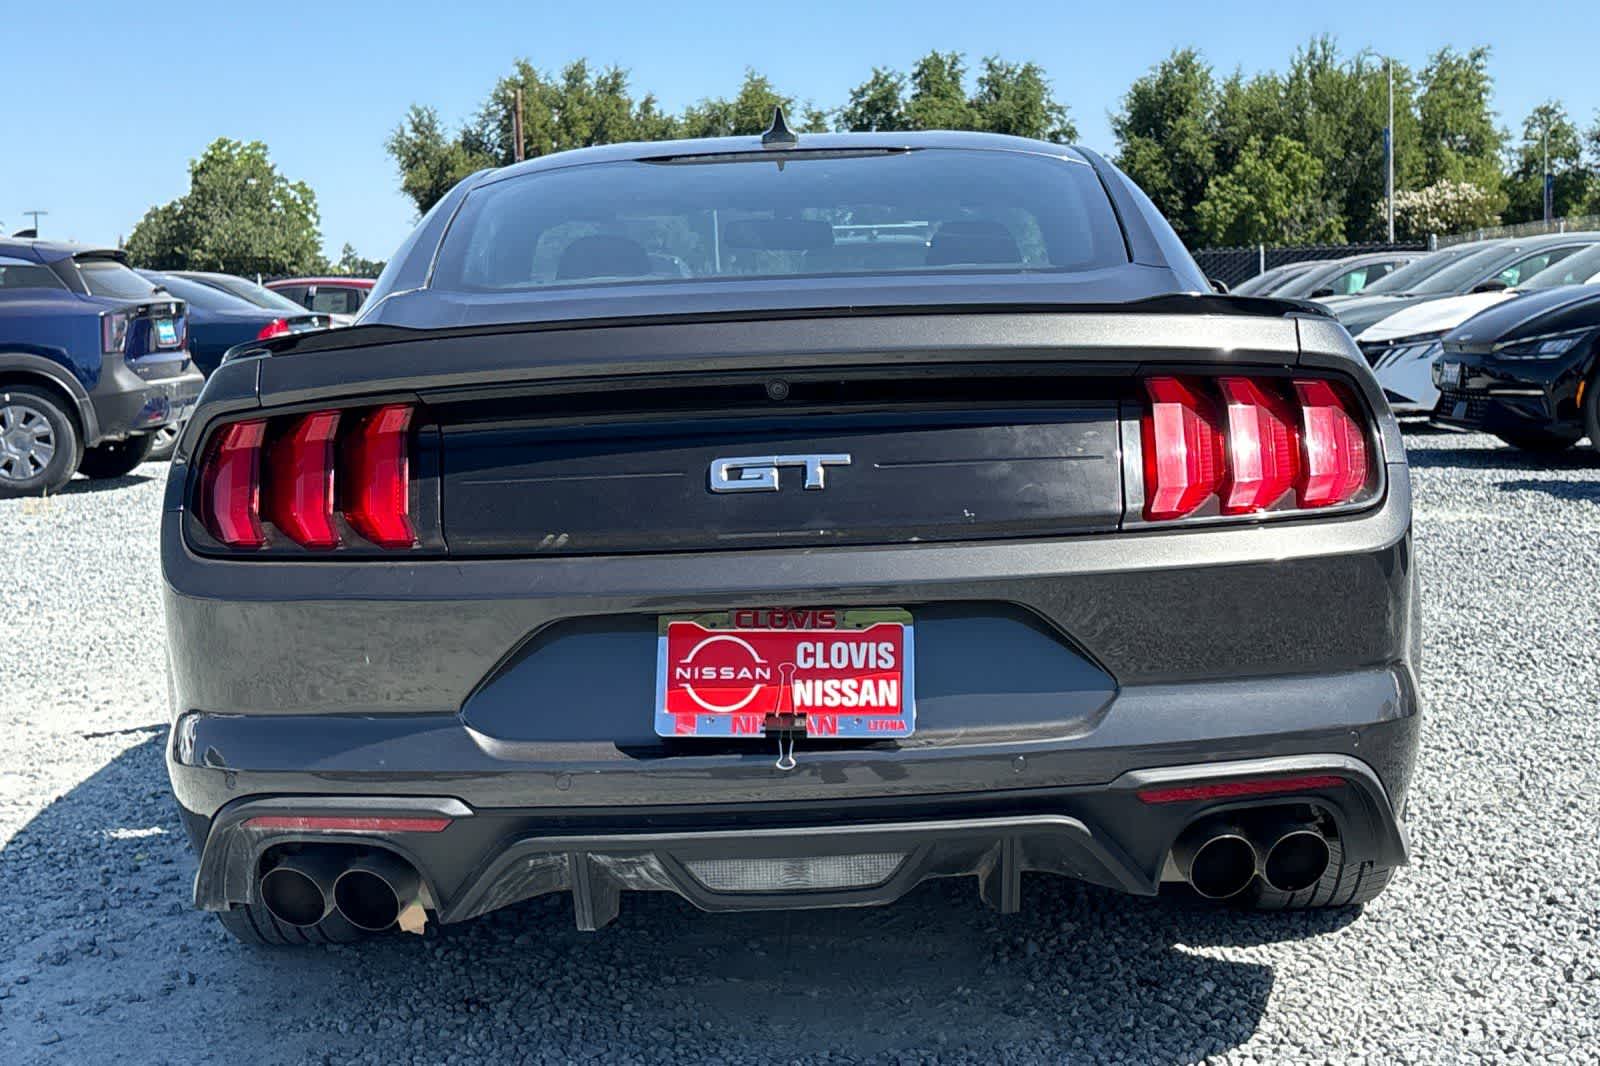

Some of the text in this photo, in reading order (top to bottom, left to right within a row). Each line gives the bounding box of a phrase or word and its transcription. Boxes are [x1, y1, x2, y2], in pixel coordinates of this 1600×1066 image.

[709, 454, 851, 492] GT
[735, 609, 836, 629] CLOVIS
[796, 641, 895, 669] CLOVIS
[675, 667, 771, 680] NISSAN
[793, 679, 898, 708] NISSAN
[731, 713, 838, 735] NIAN
